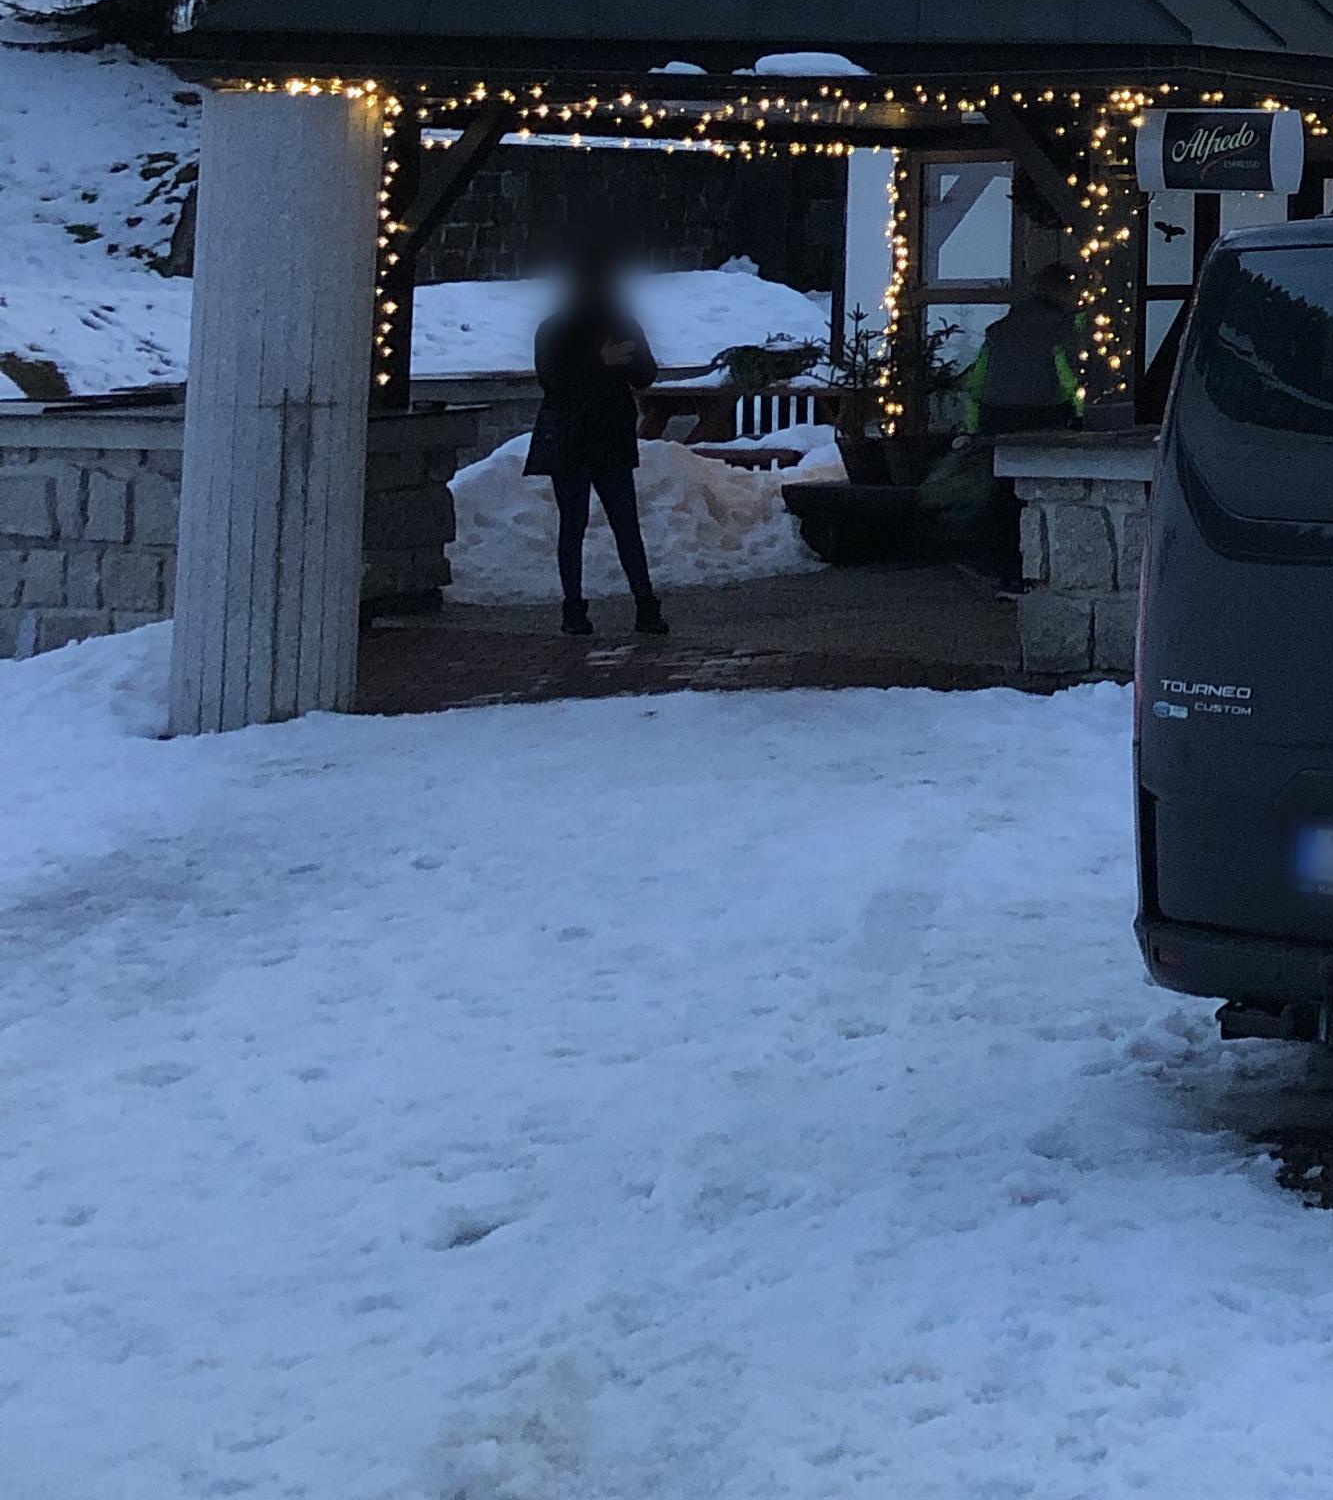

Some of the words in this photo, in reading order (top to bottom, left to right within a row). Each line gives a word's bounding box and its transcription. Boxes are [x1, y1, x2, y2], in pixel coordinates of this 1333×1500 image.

[1172, 121, 1255, 165] Alfredo
[1161, 680, 1252, 699] TOURNEO
[1194, 701, 1252, 716] CUSTOM
